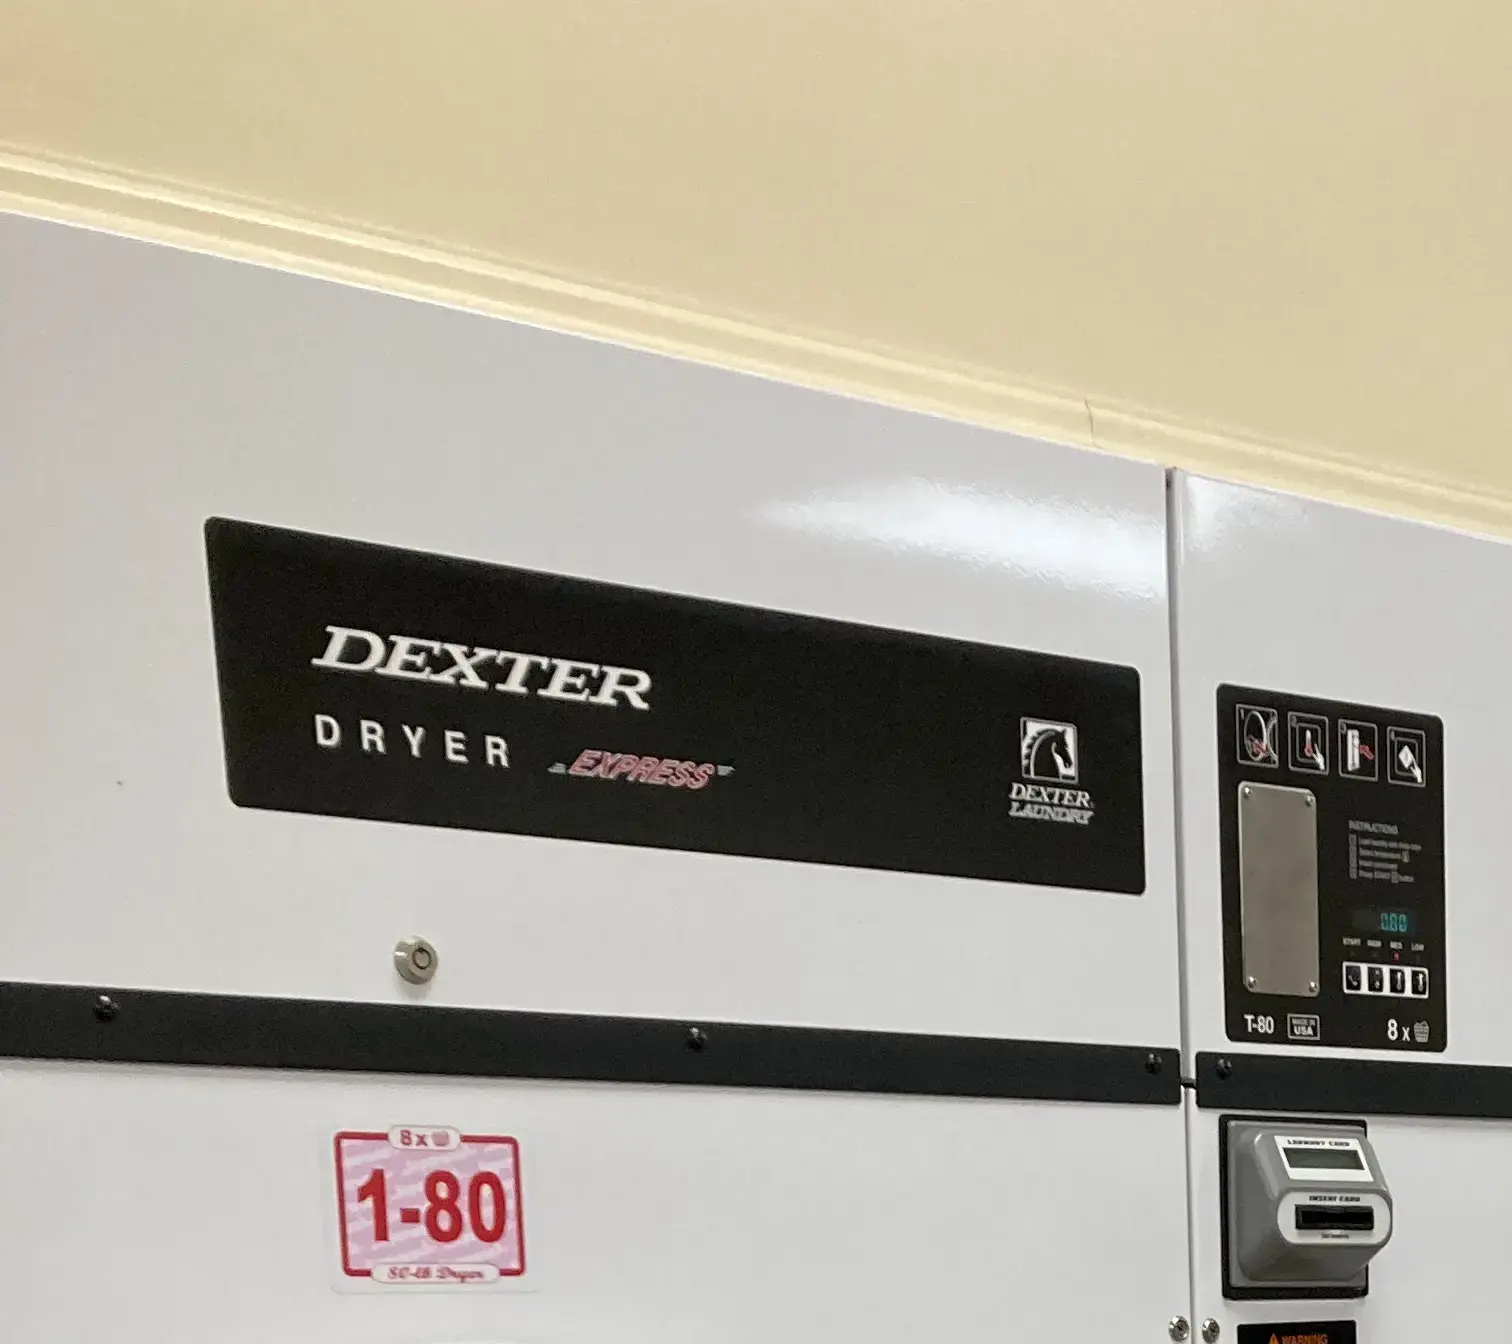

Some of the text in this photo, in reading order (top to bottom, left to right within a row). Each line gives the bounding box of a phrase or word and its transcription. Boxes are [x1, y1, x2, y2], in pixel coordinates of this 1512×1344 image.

[311, 625, 652, 711] DEXTER
[314, 714, 717, 790] DRYER EXPRESS
[1008, 782, 1092, 809] DEXTER
[1008, 801, 1095, 825] LAUNDRY
[1244, 1013, 1275, 1034] T-80
[1293, 1025, 1314, 1036] USA
[357, 1168, 507, 1243] 1-80
